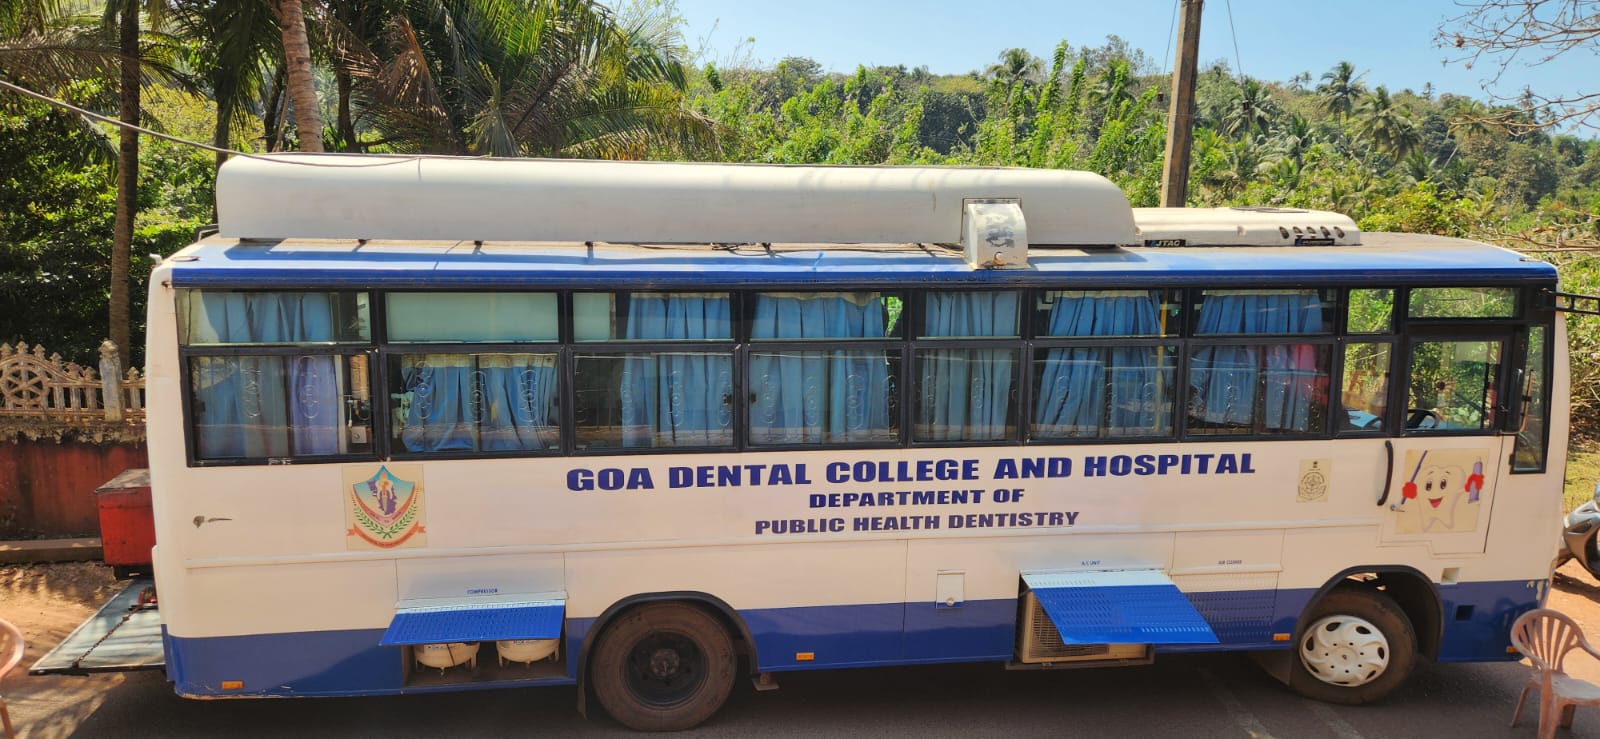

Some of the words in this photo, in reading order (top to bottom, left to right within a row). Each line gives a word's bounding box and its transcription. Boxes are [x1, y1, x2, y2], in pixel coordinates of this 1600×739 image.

[566, 467, 655, 492] GOA
[668, 464, 812, 488] DENTAL
[826, 460, 980, 483] COLLEGE
[993, 457, 1072, 481] AND
[1083, 453, 1256, 477] HOSPITAL
[809, 490, 986, 508] DEPARTMENT
[992, 488, 1025, 504] OF
[755, 516, 845, 535] PUBLIC
[853, 515, 940, 532] HEALTH
[948, 511, 1080, 529] DENTISTRY
